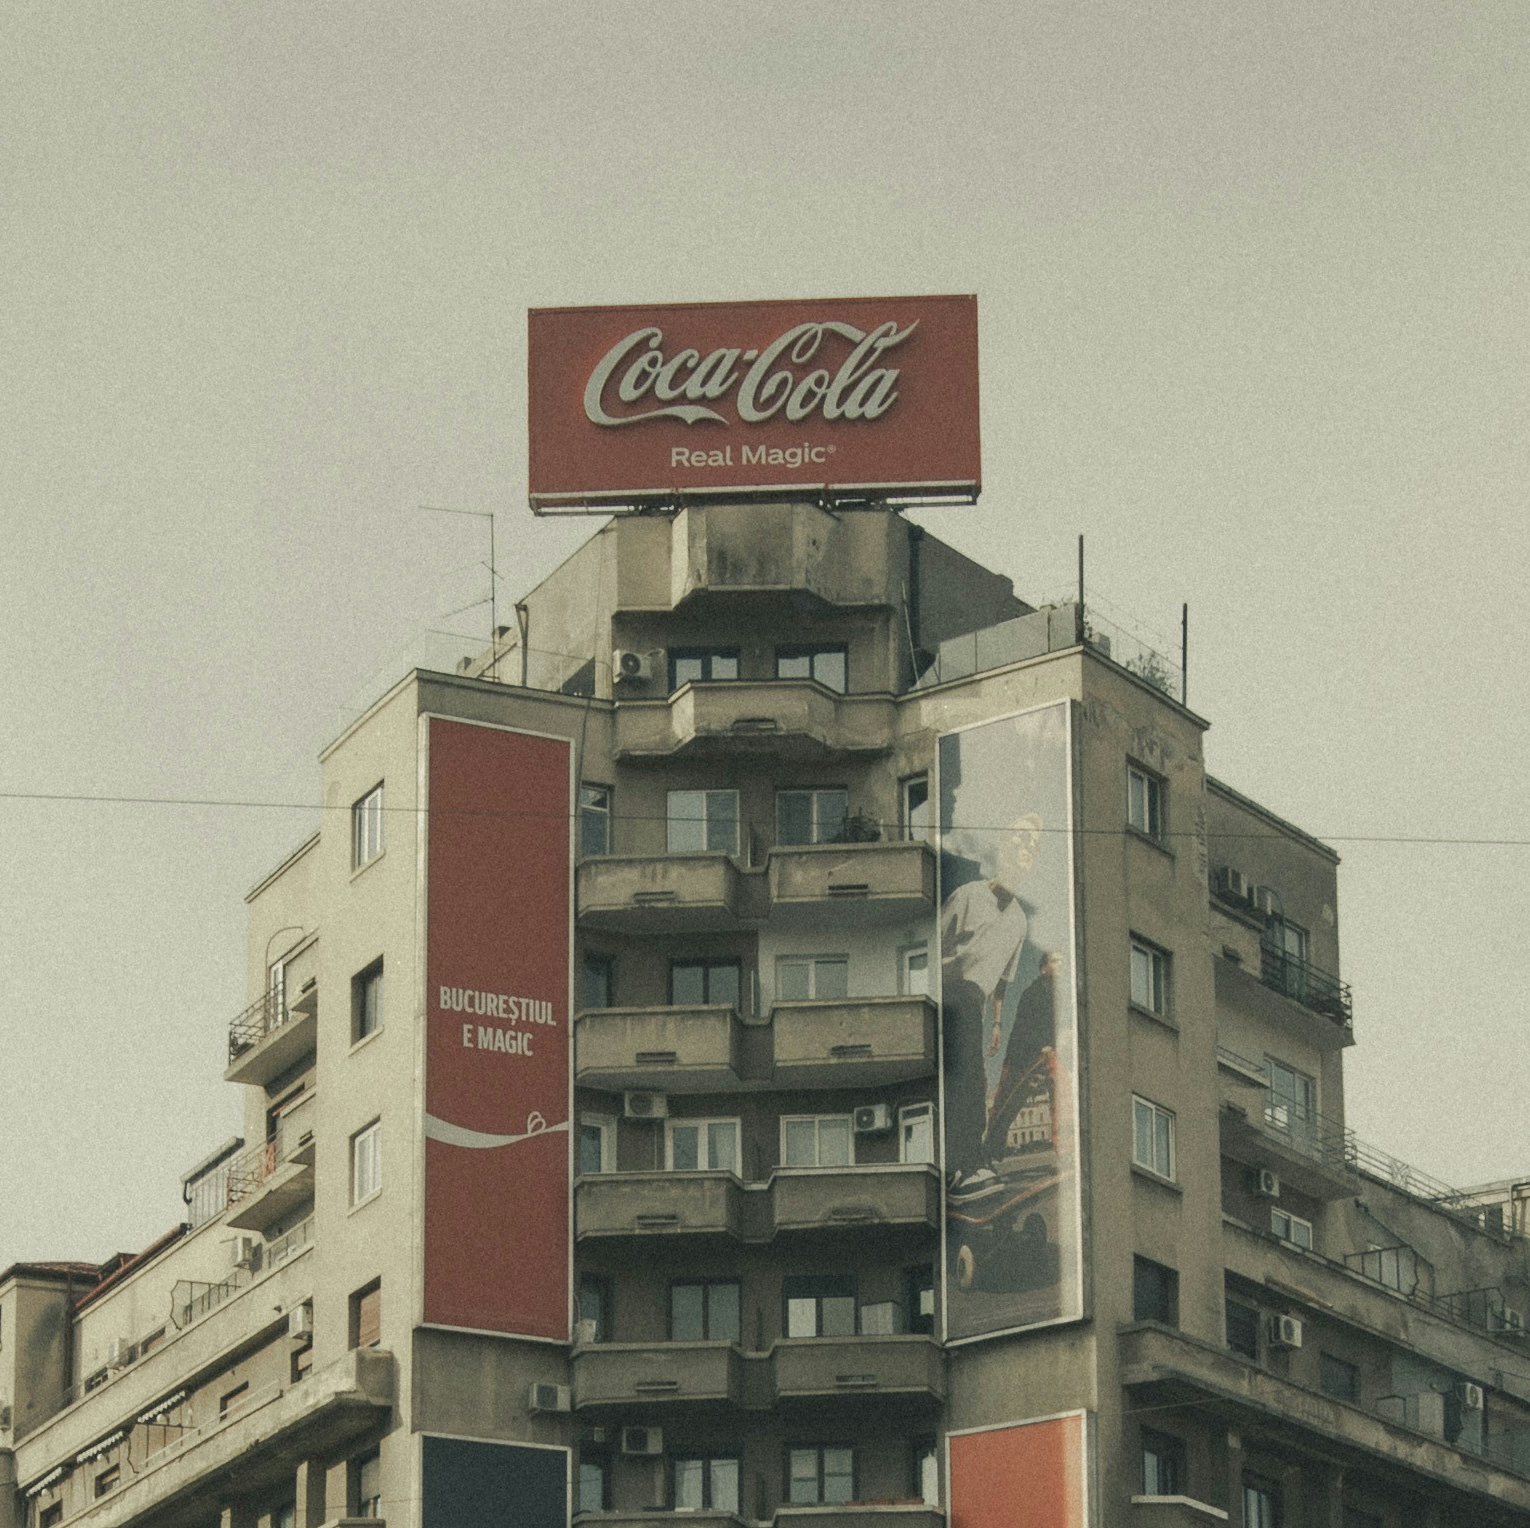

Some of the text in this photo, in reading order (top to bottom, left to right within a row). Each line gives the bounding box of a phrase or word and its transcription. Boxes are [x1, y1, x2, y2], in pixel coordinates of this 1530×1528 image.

[583, 319, 920, 427] Coca-Cola
[671, 447, 732, 468] Real
[440, 986, 556, 1026] BUCUREȘTIUL
[463, 1023, 533, 1056] E MAGIC
